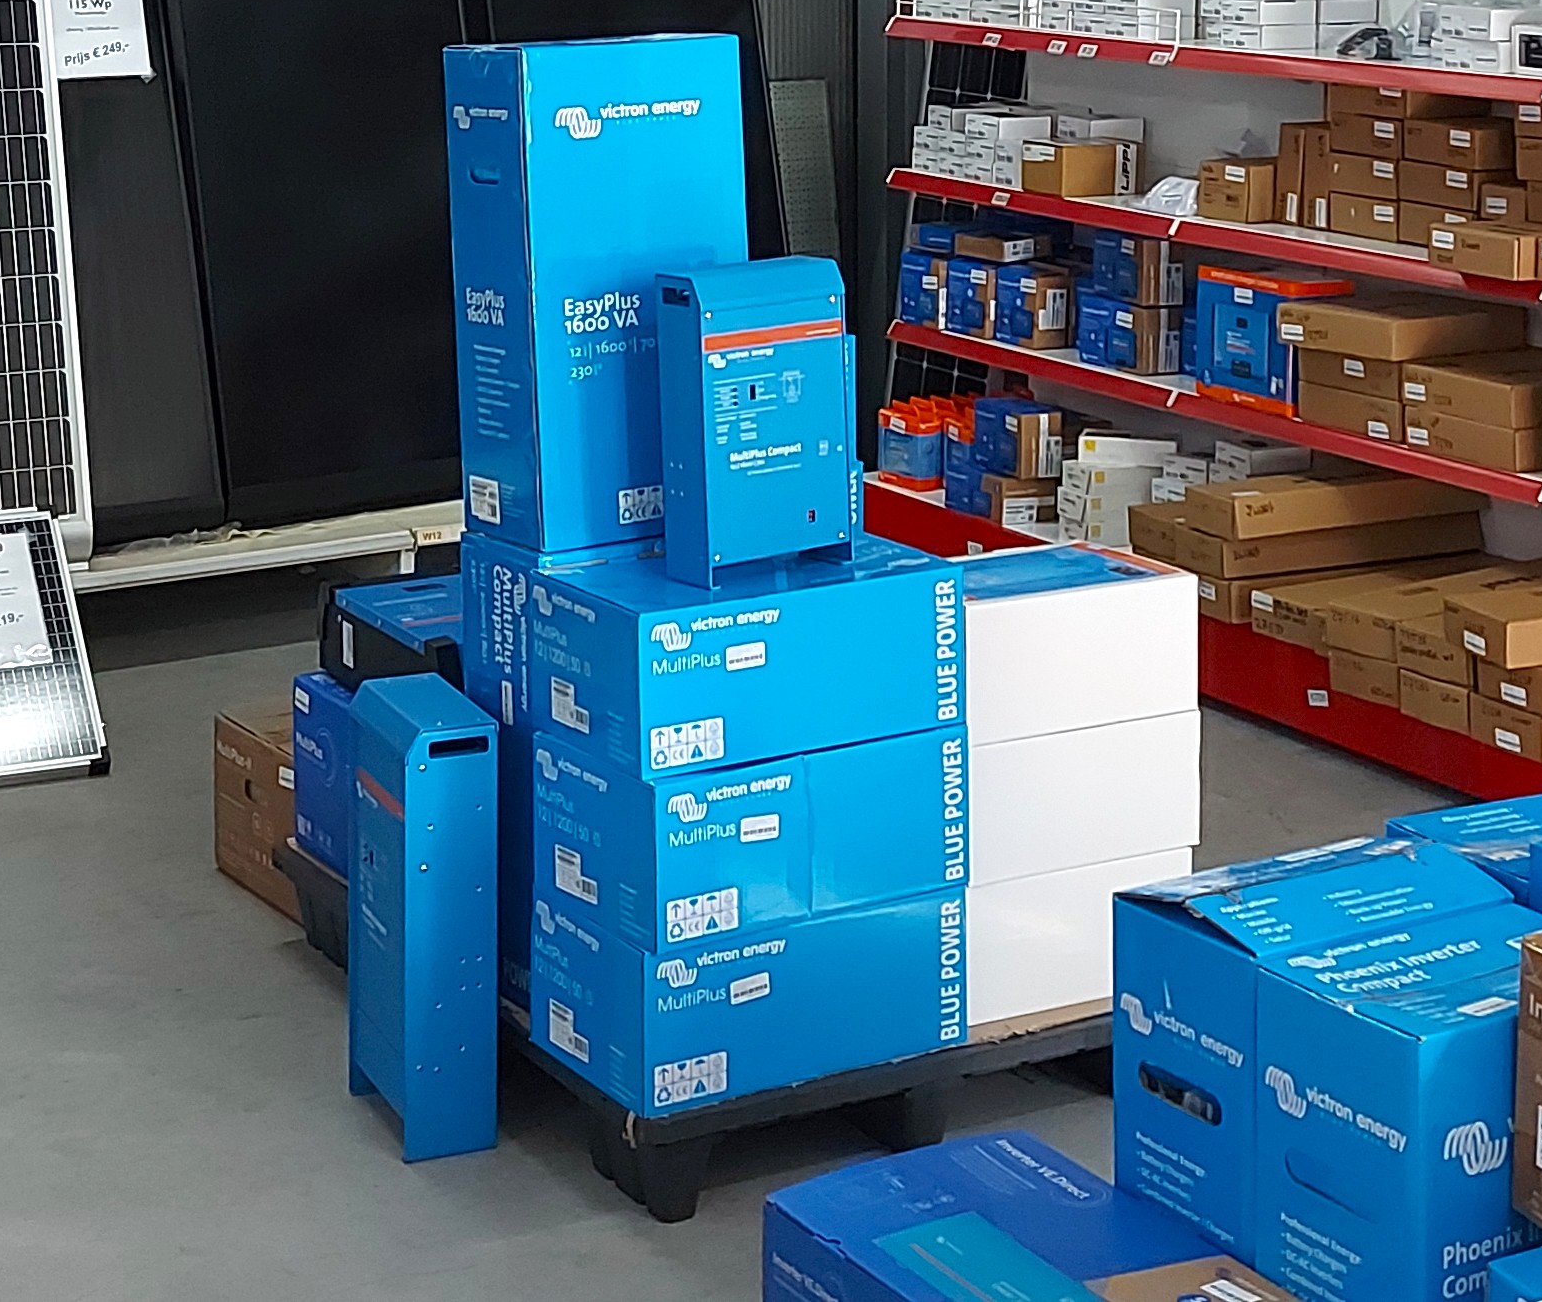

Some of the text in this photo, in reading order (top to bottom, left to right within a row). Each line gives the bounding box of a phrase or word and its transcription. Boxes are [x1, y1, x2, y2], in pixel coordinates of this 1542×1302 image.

[69, 0, 111, 10] 115 Wp
[65, 42, 129, 66] Prijs € 249,-
[601, 100, 700, 119] victron energy
[466, 288, 504, 312] EasyPlus
[564, 292, 640, 318] EasyPlus
[467, 308, 504, 326] 1600 VA
[564, 310, 639, 334] 1600 VA
[730, 443, 802, 462] MultiPlus Compact
[491, 565, 504, 664] Compact
[501, 567, 514, 674] MultiPlus
[691, 607, 780, 633] victron energy
[935, 579, 958, 721] BLUE POWER
[652, 651, 721, 676] MultiPlus
[706, 773, 791, 802] victron energy
[942, 739, 965, 881] BLUE POWER
[669, 822, 736, 847] MultiPlus
[696, 938, 786, 967] victron energy
[1367, 933, 1411, 948] energy
[940, 899, 960, 1041] BLUE POWER
[1316, 940, 1481, 984] Phoenix Inverter
[1337, 969, 1431, 992] Compact
[658, 988, 726, 1013] MultiPlus
[1153, 1011, 1244, 1069] victron energy
[1306, 1087, 1408, 1153] victron energy
[996, 1139, 1090, 1200] Inverter VE.Direct
[1443, 1227, 1522, 1269] Phoenix
